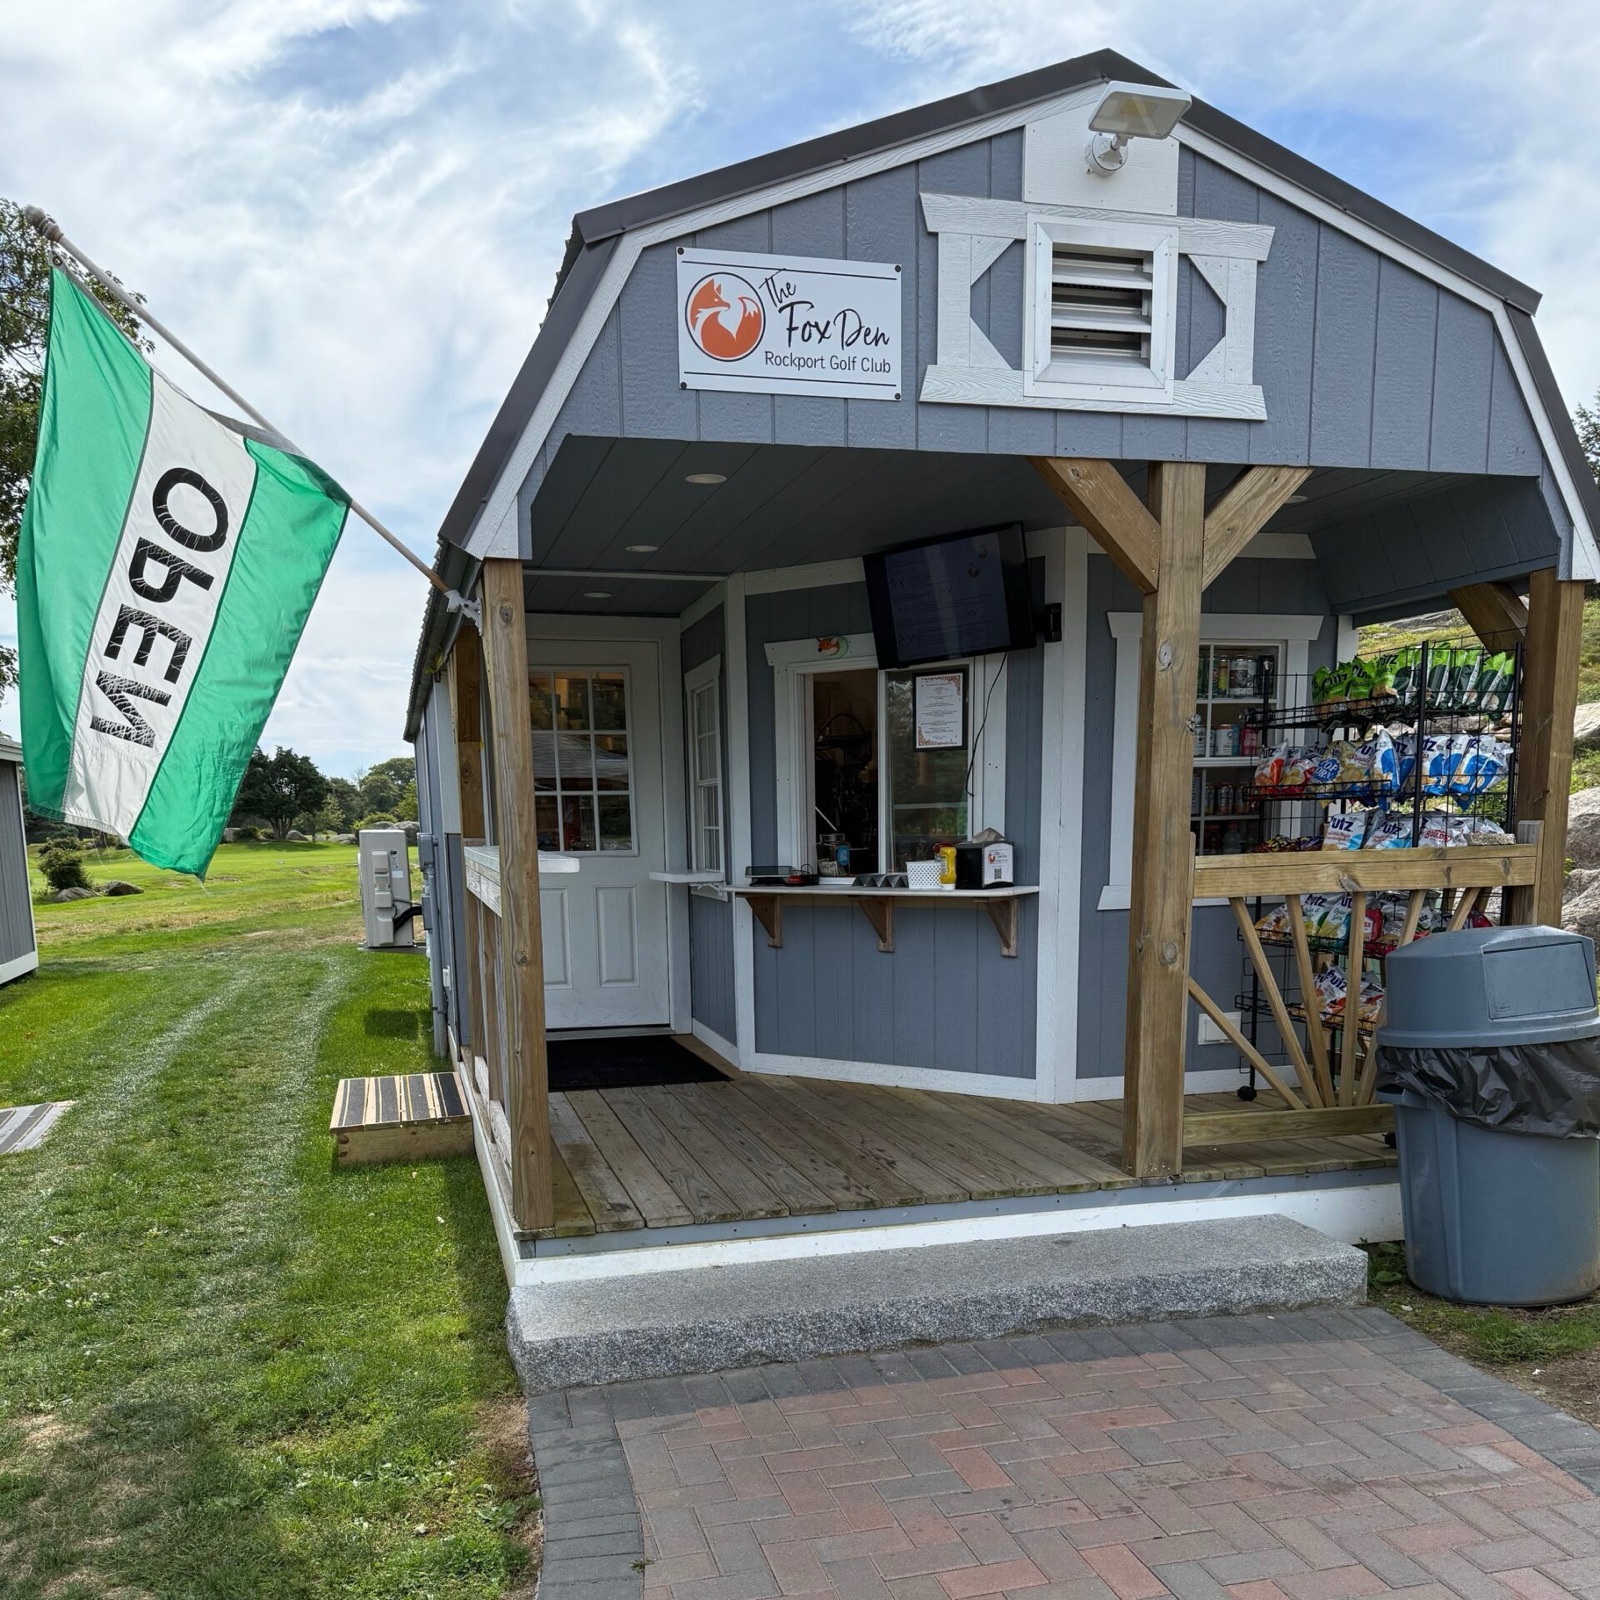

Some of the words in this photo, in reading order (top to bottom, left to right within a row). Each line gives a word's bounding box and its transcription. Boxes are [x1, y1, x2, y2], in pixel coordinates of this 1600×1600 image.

[758, 267, 796, 308] The
[778, 300, 832, 348] Fox
[833, 308, 890, 351] Den
[765, 351, 825, 371] Rockport
[830, 354, 857, 371] Golf
[861, 357, 891, 374] Club
